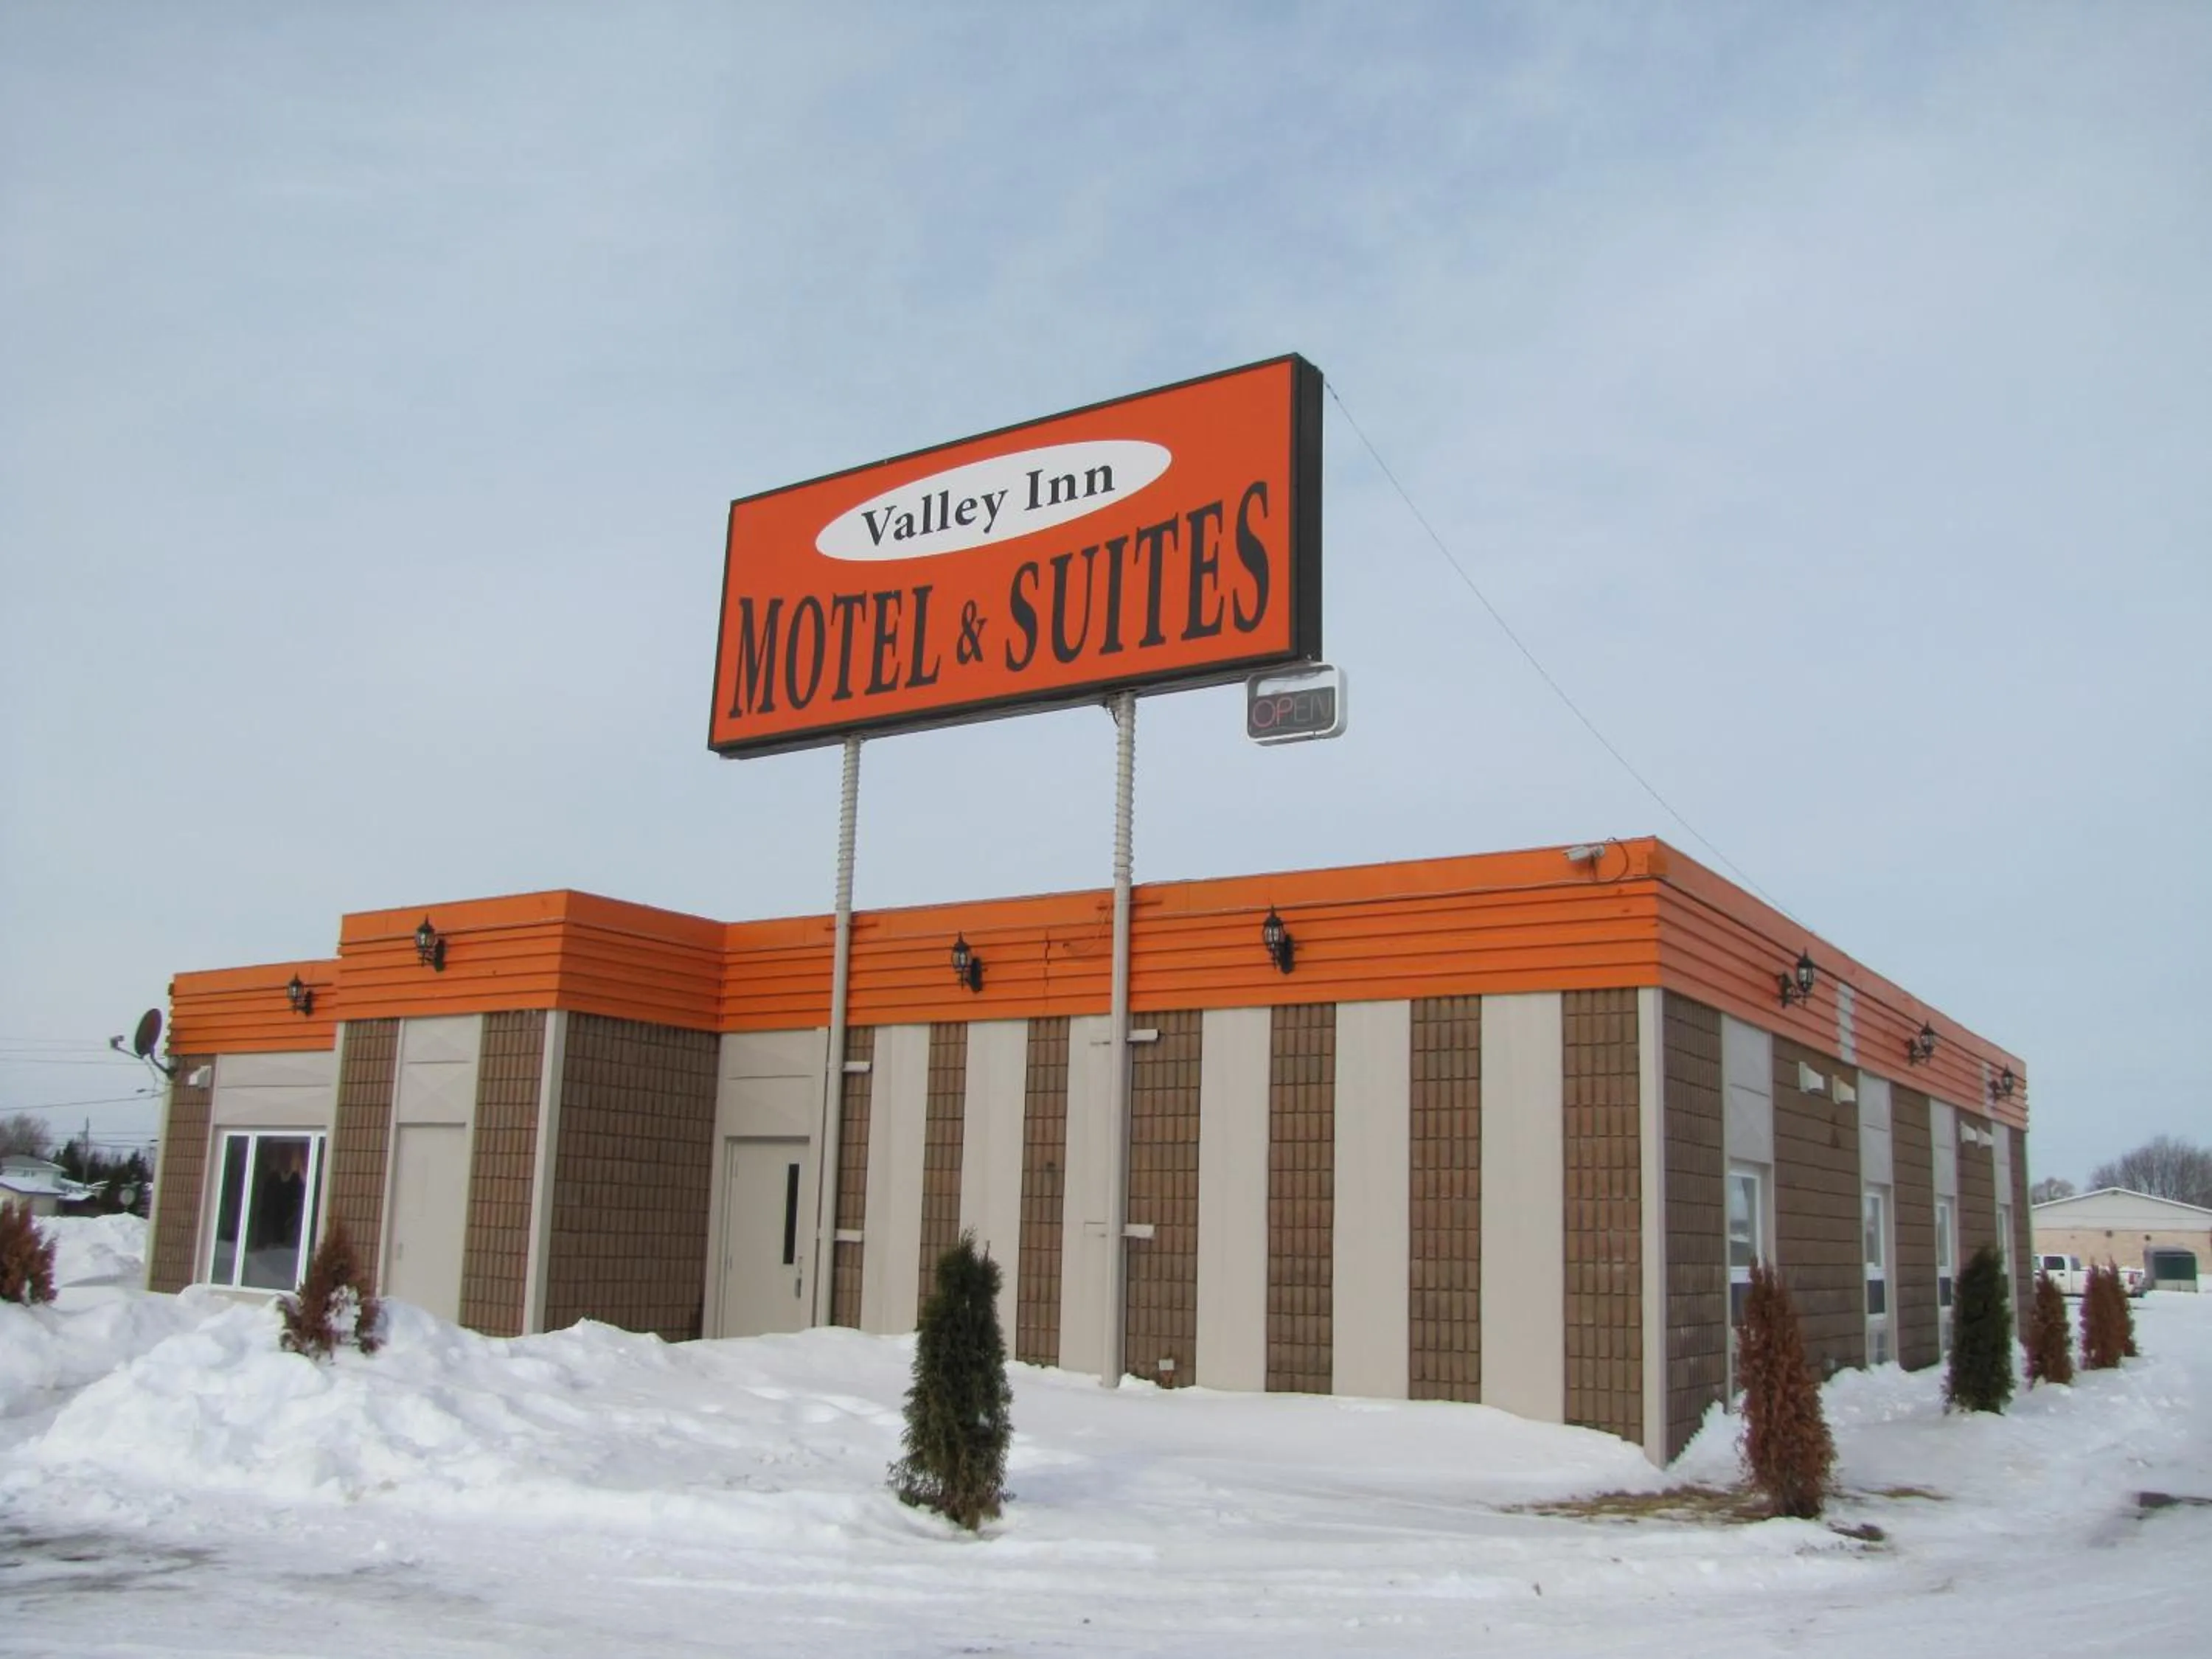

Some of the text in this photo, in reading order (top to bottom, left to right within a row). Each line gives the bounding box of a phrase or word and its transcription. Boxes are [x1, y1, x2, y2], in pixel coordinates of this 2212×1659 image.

[861, 464, 1116, 547] Valley Inn
[728, 481, 1270, 718] MOTEL & SUITES
[1253, 692, 1332, 728] OPEN
